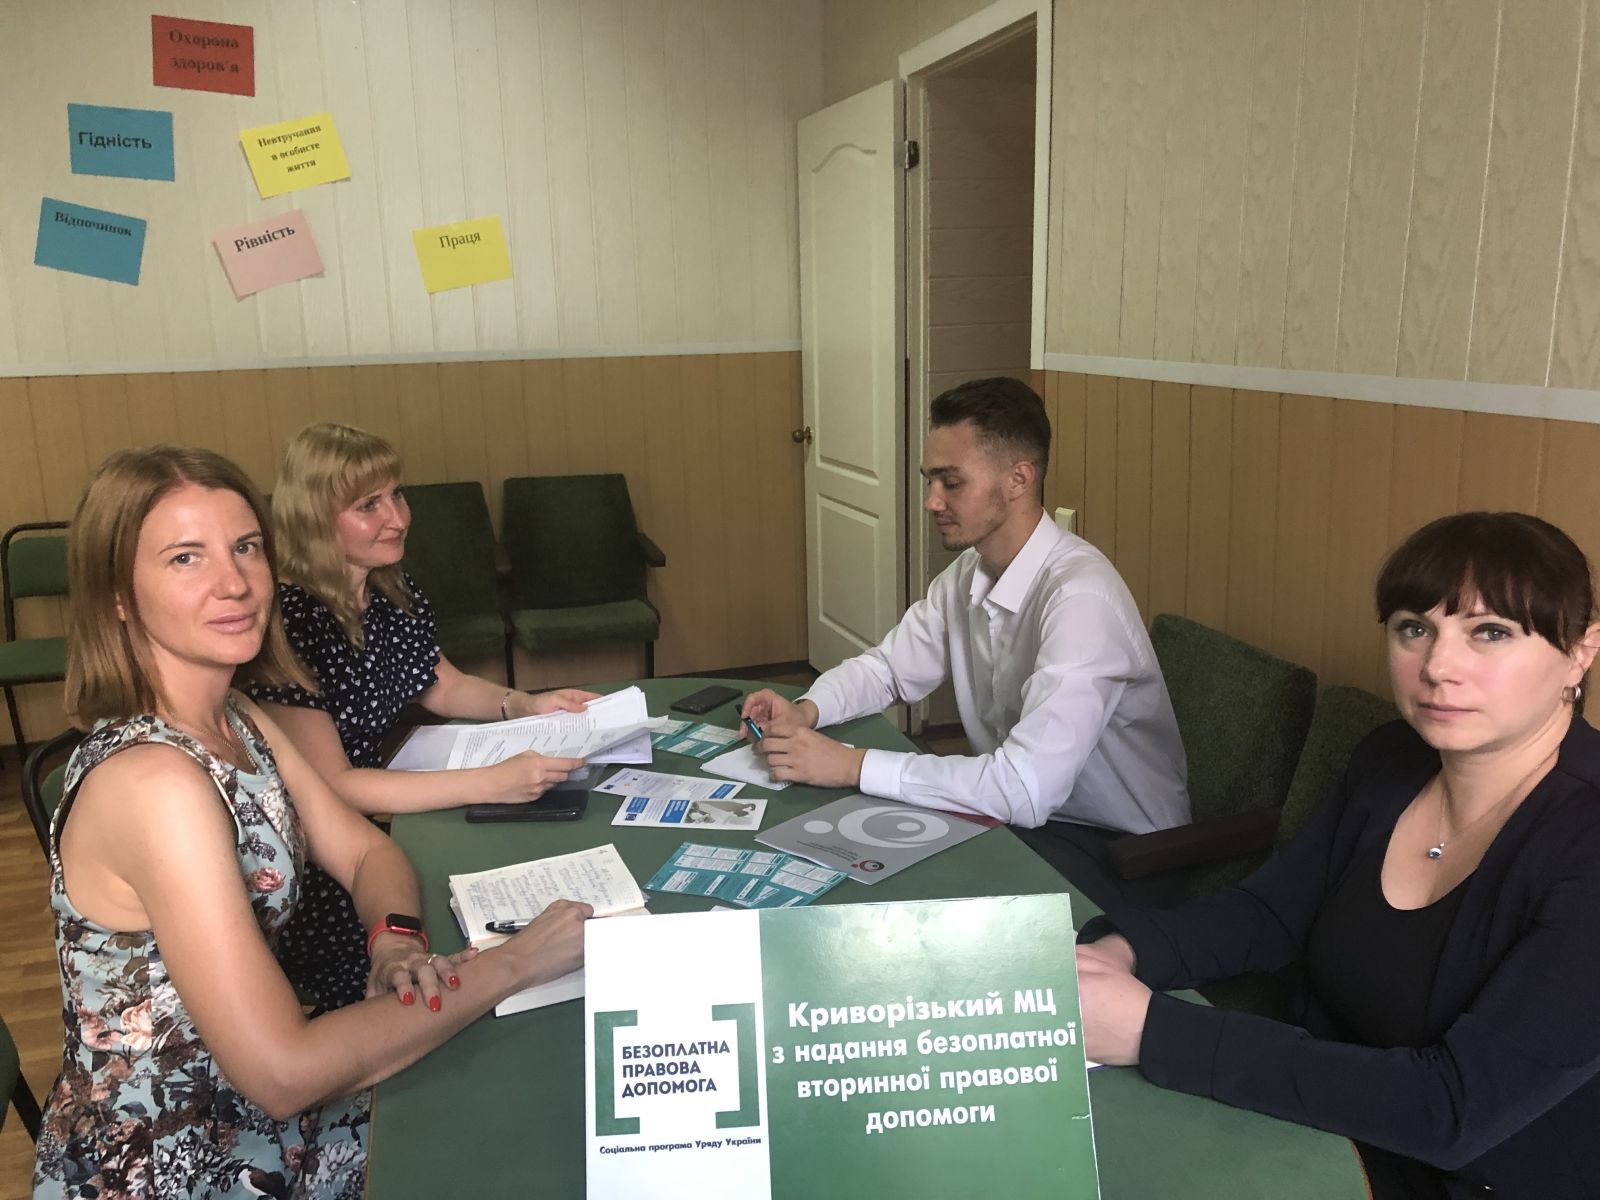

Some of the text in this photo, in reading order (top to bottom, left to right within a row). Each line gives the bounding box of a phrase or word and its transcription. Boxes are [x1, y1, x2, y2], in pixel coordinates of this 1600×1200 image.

[169, 28, 239, 49] Охорона
[78, 131, 152, 149] Гідність
[257, 125, 322, 148] Невтручання
[271, 142, 320, 161] в особисте
[286, 159, 317, 173] життя
[54, 211, 133, 237] Відпочинок
[234, 226, 296, 253] Рівність
[438, 232, 481, 249] Праця
[788, 988, 1057, 1033] Криворізький МЦ
[621, 1039, 731, 1060] БЕЗОПЛАТНА
[771, 1021, 1077, 1065] з надання безоплатної
[622, 1060, 702, 1079] ПРАВОВА
[797, 1056, 1058, 1102] вторинної правової
[621, 1078, 718, 1099] ДОПОМОГА
[865, 1104, 996, 1135] допомоги
[599, 1136, 762, 1156] Соціальна програма Уряду України
